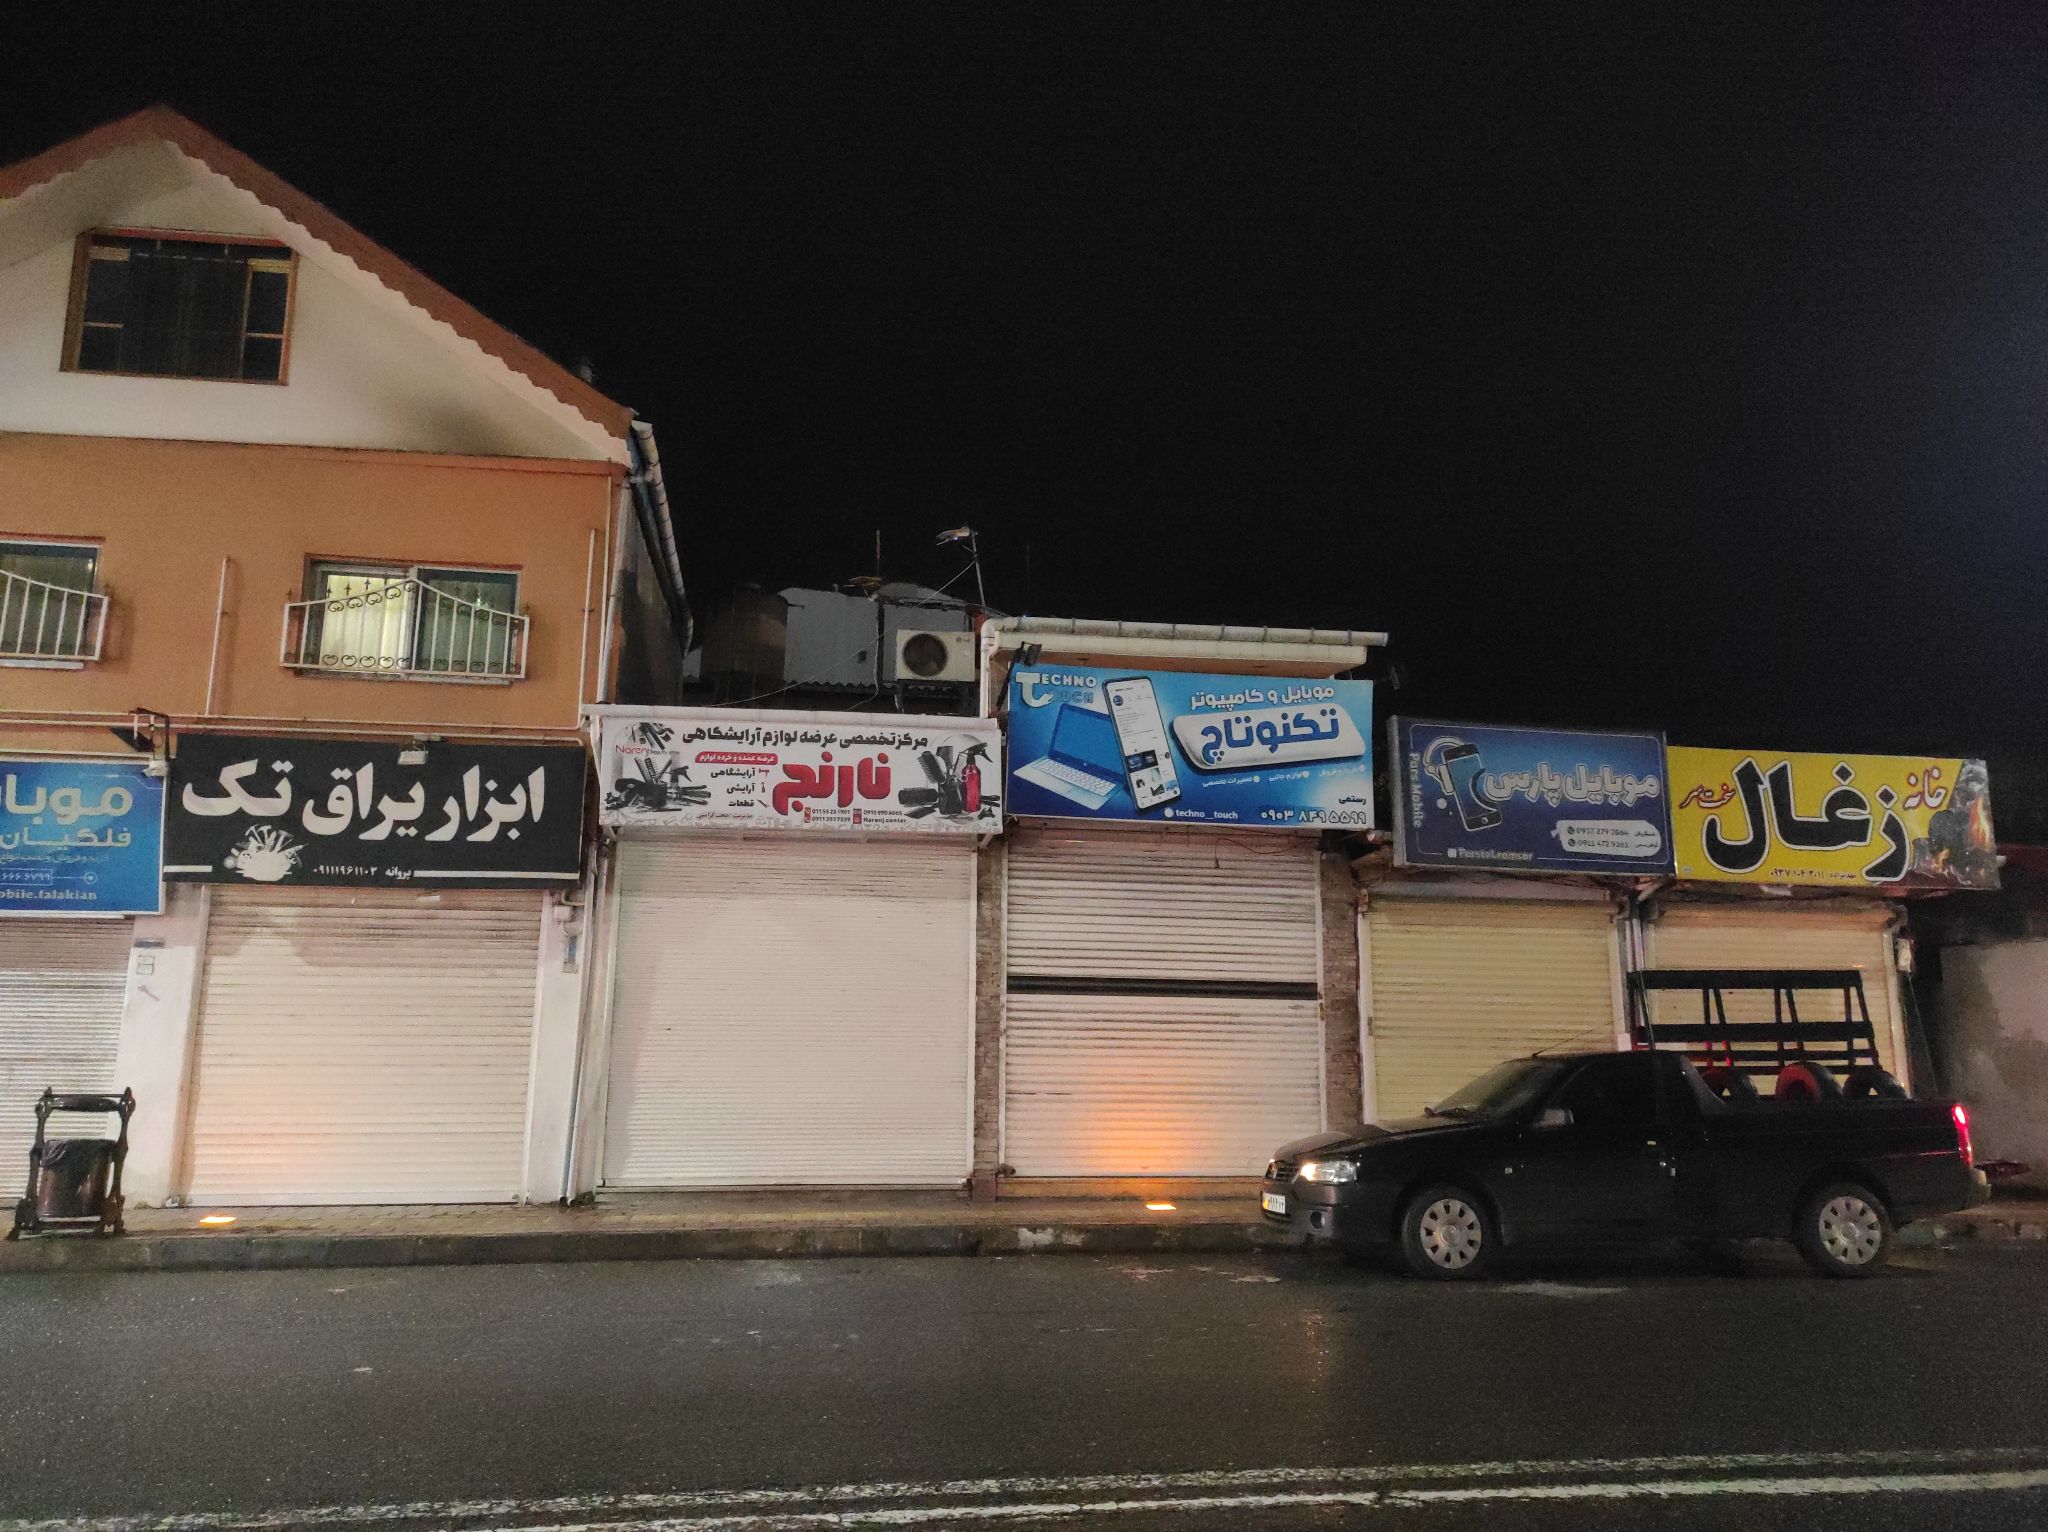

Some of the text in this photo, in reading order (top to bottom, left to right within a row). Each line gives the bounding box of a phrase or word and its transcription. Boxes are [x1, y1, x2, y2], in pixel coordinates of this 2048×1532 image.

[1191, 685, 1335, 711] موبایل و کامپیوتر
[682, 726, 928, 751] مرکز تخصصی عرضه لوازم آرایشگاهی
[1200, 708, 1340, 766] تکنوتاچ
[710, 767, 756, 779] آرایشگاهی
[726, 782, 755, 795] آرایشی
[772, 751, 891, 816] نارنج
[1408, 752, 1425, 829] Pars Mobile
[1484, 762, 1661, 808] موبایل پارس
[1902, 767, 1949, 811] خانه
[0, 773, 134, 826] موبا
[182, 758, 546, 842] ابزار یراق تک
[728, 799, 755, 807] قطعات
[1701, 756, 1911, 881] زغال
[0, 826, 132, 850] فلکیان
